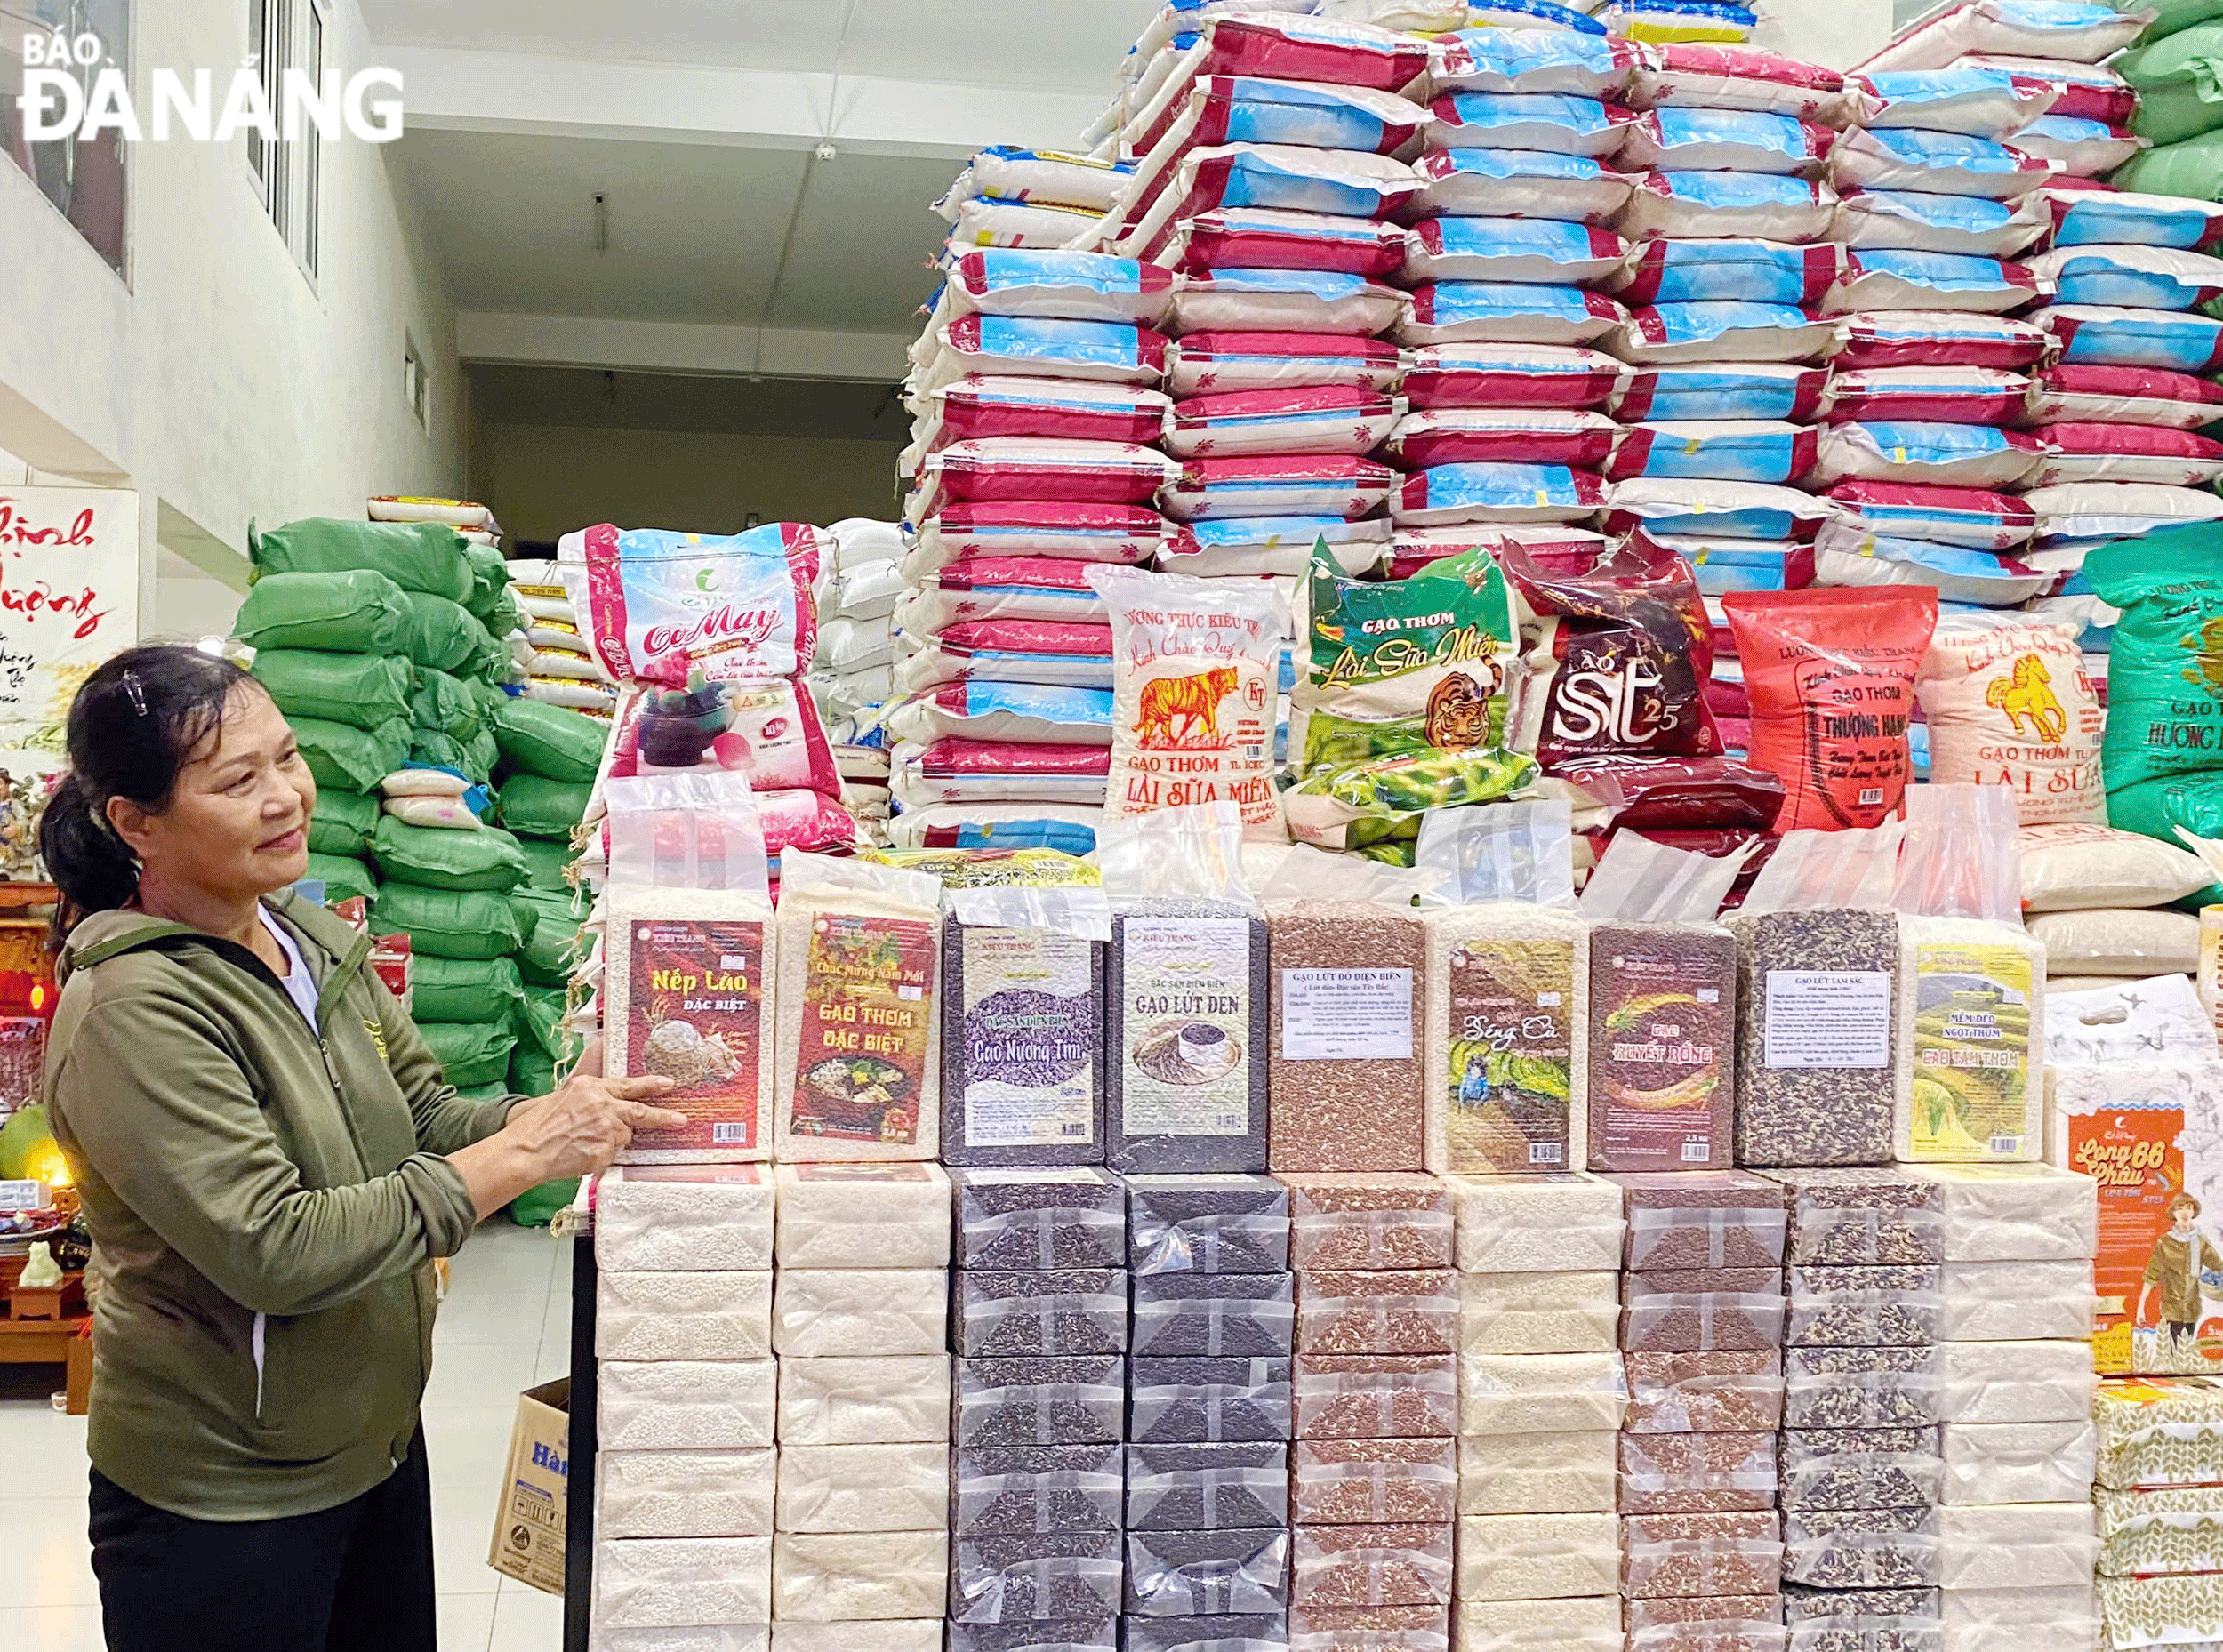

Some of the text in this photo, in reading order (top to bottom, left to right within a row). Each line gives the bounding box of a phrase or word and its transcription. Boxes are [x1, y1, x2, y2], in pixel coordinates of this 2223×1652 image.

[1361, 612, 1455, 635] GẠO THƠM
[1319, 646, 1369, 690] Lài
[1373, 639, 1429, 677] Sữa
[1642, 698, 1682, 731] 25
[1167, 755, 1219, 773] THƠM
[2025, 745, 2071, 760] THƠM
[1127, 773, 1160, 805] LÀI
[651, 968, 749, 997] Nếp Lào
[1293, 973, 1314, 983] GẠO
[1354, 972, 1377, 982] ĐIỆN
[1379, 970, 1402, 980] BIÊN
[683, 998, 747, 1014] ĐẶC BIỆT
[819, 1004, 912, 1027] GẠO THƠM
[1136, 990, 1240, 1018] GẠO LỨT ĐEN
[823, 1029, 904, 1055] ĐẶC BIỆT
[2075, 1138, 2167, 1169] Long 66
[2088, 1159, 2146, 1187] Châu
